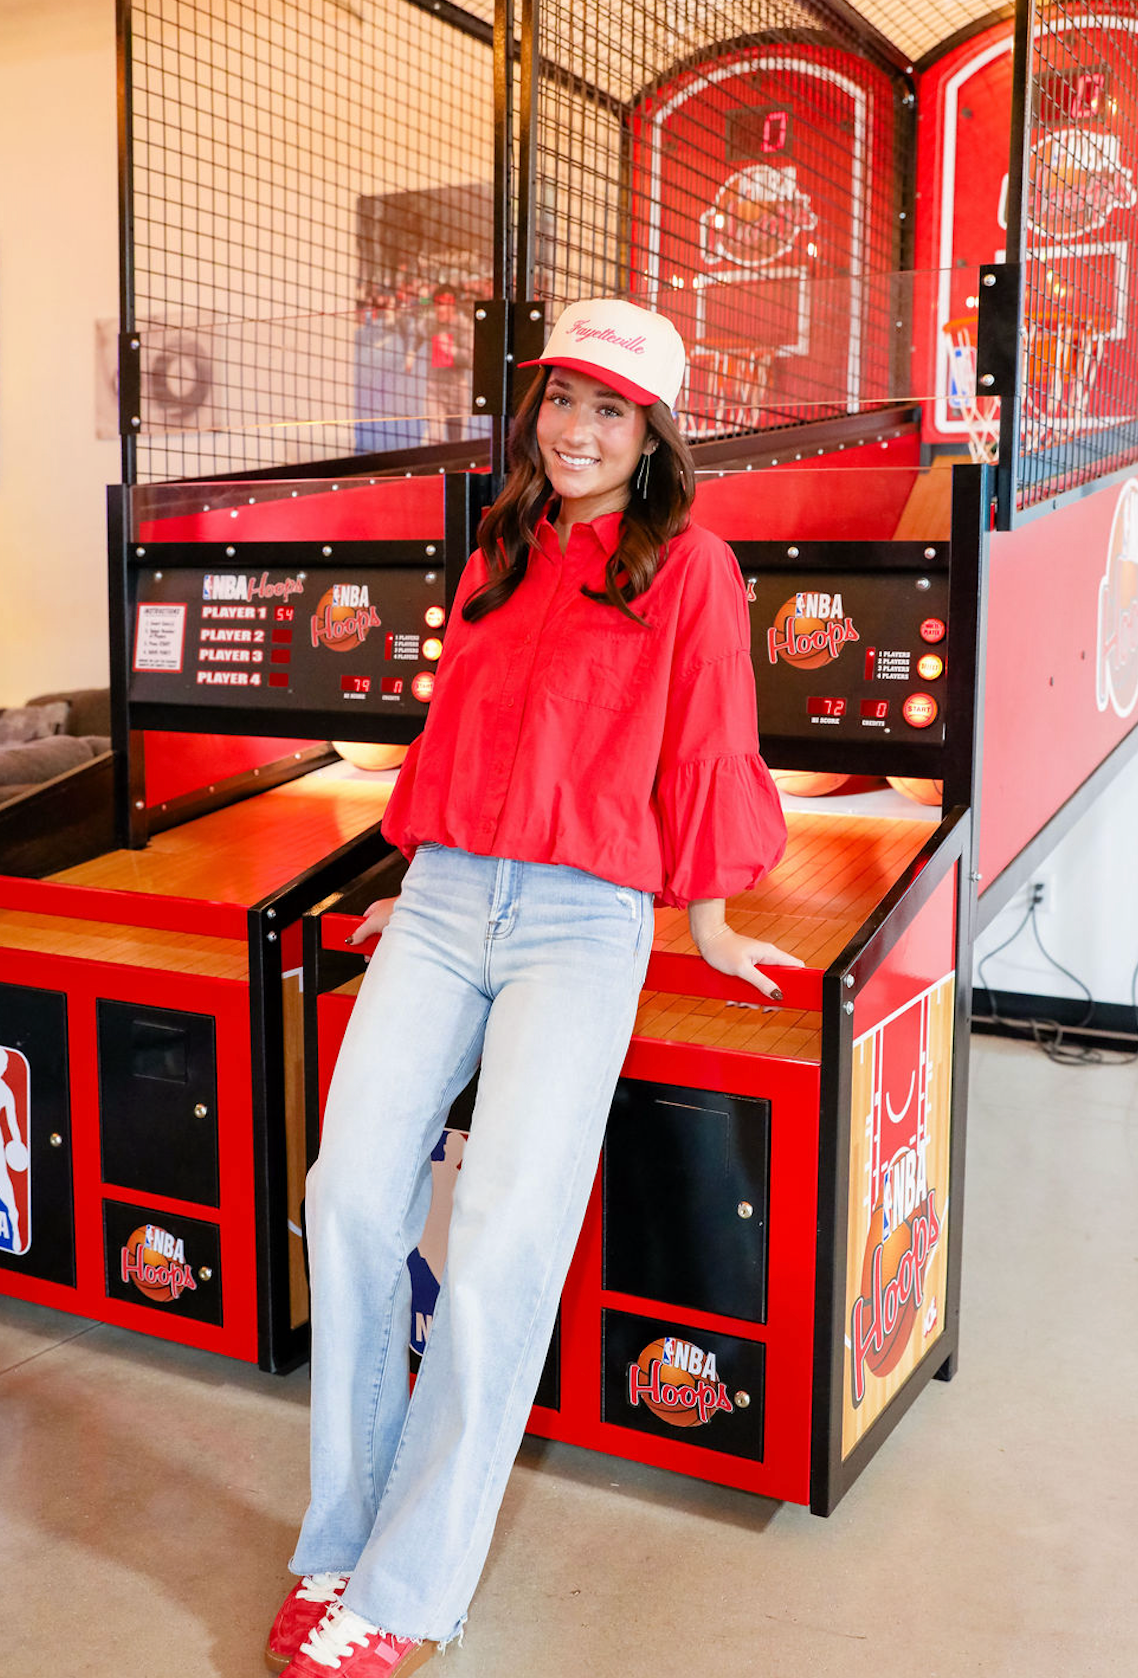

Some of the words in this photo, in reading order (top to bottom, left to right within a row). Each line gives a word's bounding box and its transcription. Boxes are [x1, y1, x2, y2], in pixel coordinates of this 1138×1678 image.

[1072, 73, 1105, 119] 0
[761, 111, 789, 153] 0
[565, 319, 647, 355] Fayetteville
[212, 574, 248, 600] NBA
[246, 571, 304, 602] Hoops
[340, 584, 370, 608] NBA
[201, 605, 256, 619] PLAYER
[257, 606, 268, 619] 1
[276, 608, 294, 621] 54
[805, 593, 844, 619] NBA
[200, 628, 252, 642] PLAYER
[253, 629, 265, 643] 2
[311, 605, 381, 648] Hoops
[767, 617, 860, 664] Hoops
[198, 648, 250, 662] PLAYER
[251, 650, 263, 663] 3
[883, 665, 910, 673] PLAYERS
[196, 670, 248, 686] PLAYER
[249, 672, 262, 687] 4
[824, 700, 844, 716] 72
[876, 702, 887, 718] 0
[907, 705, 931, 714] START
[890, 1148, 927, 1231] NBA
[152, 1229, 186, 1264] NBA
[120, 1244, 197, 1299] Hoops
[852, 1189, 941, 1402] Hoops
[674, 1342, 719, 1382] NBA
[628, 1358, 735, 1424] Hoops
